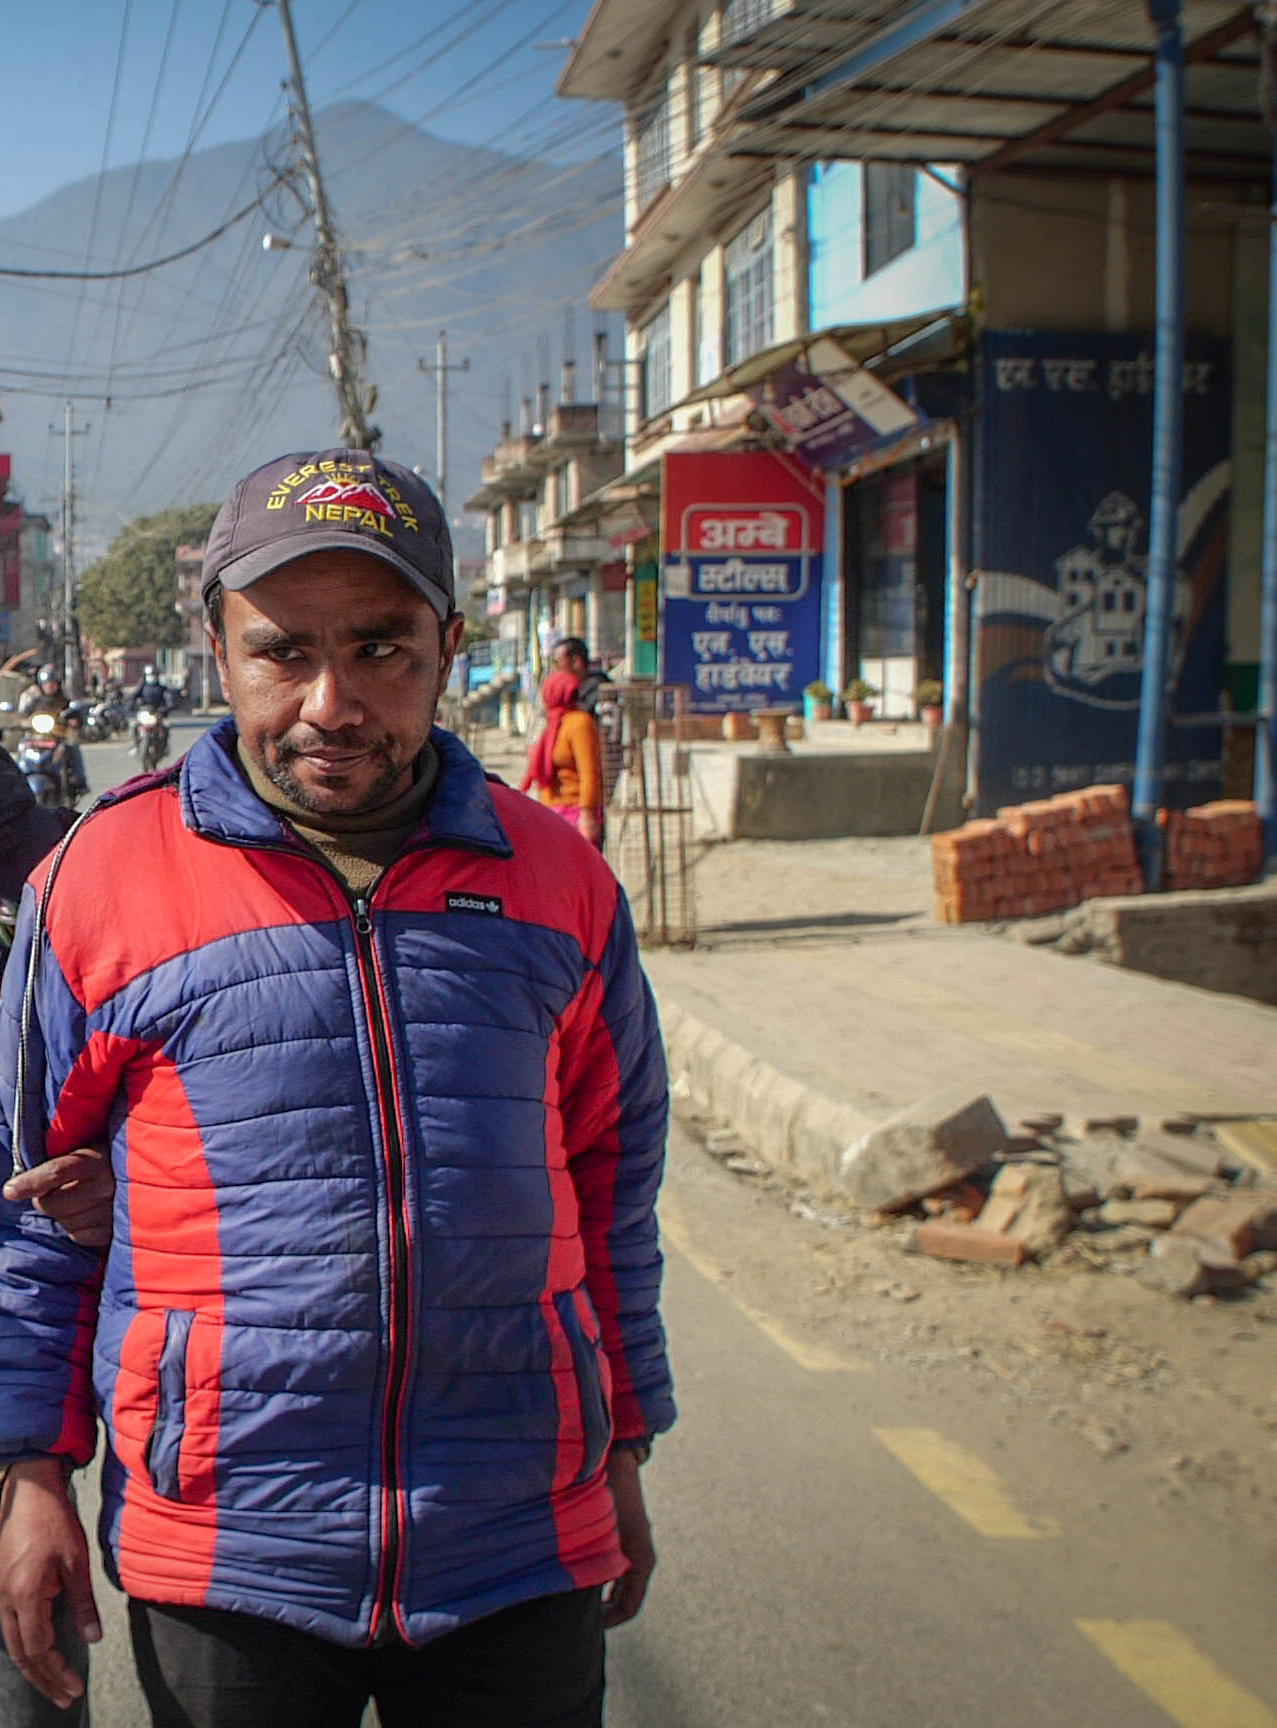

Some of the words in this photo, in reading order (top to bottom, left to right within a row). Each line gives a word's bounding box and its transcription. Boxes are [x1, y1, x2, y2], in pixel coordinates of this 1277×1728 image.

[267, 460, 371, 510] EVEREST
[377, 473, 419, 533] TREK
[306, 504, 394, 539] NEPAL
[448, 897, 485, 911] adidas
